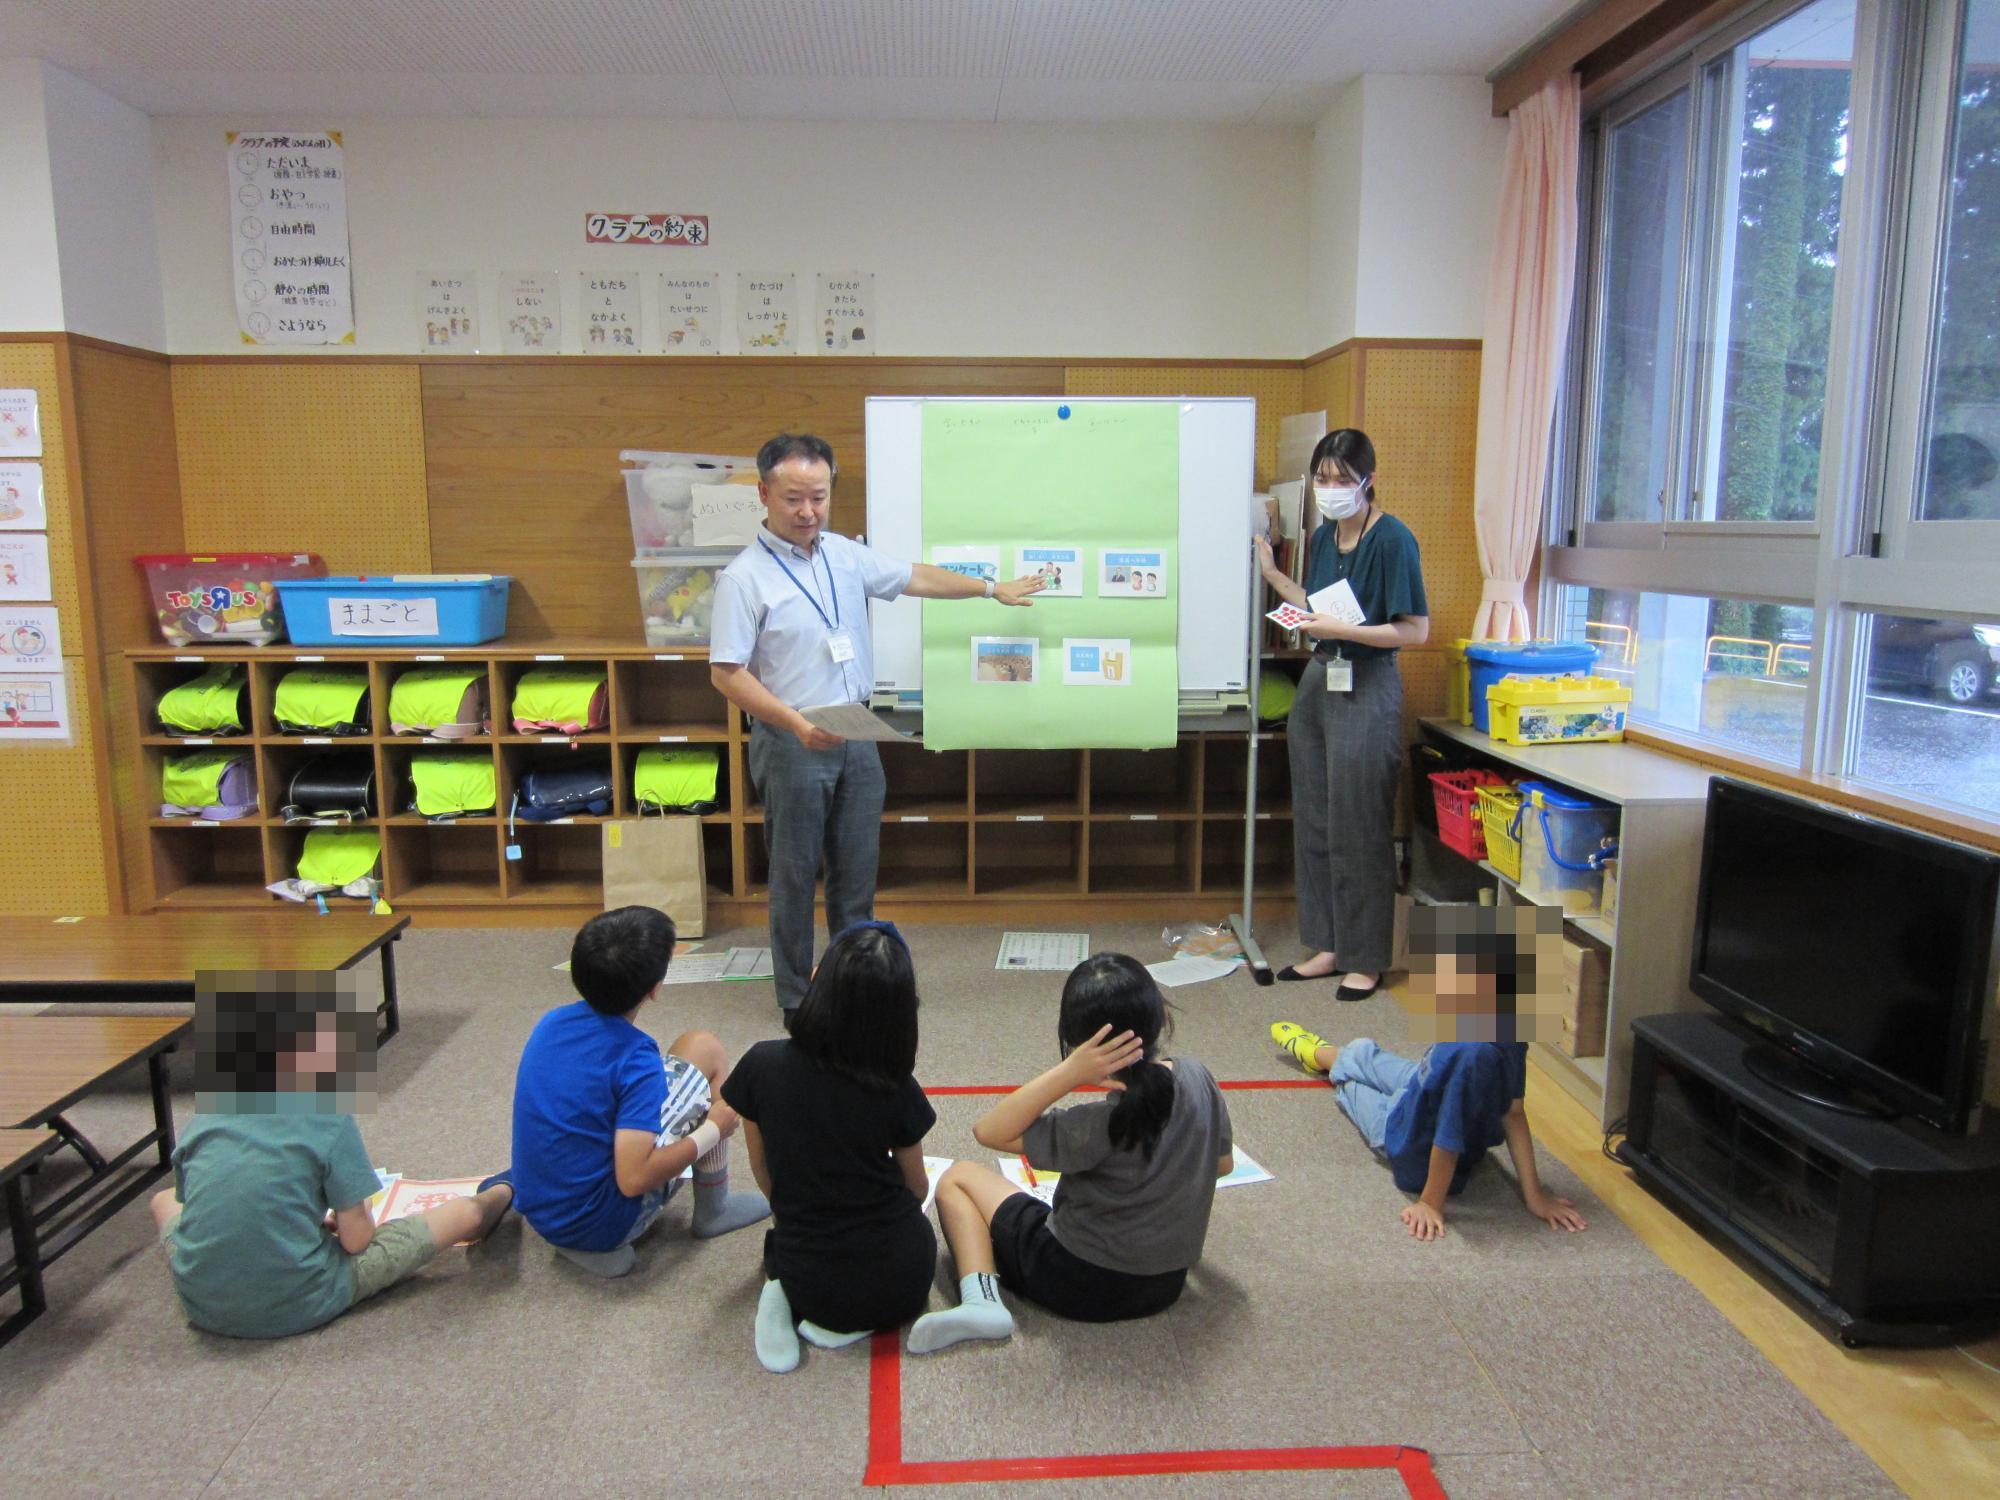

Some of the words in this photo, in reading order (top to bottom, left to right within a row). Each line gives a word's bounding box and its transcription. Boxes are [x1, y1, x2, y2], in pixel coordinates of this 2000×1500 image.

[266, 156, 311, 169] ただいま
[270, 187, 306, 200] おやつ
[271, 222, 316, 236] 自由時間
[591, 218, 703, 243] クラブの約束
[590, 280, 627, 290] ともだち
[667, 280, 710, 288] みんなのもの
[750, 282, 784, 291] かたづけ
[828, 281, 860, 290] むかえが
[685, 292, 692, 300] は
[834, 295, 857, 304] きたら
[516, 297, 542, 306] しない
[605, 297, 612, 306] と
[763, 297, 771, 305] は
[427, 306, 466, 315] げんきよく
[669, 305, 709, 313] たいせつに
[826, 308, 864, 317] すぐかえる
[591, 312, 626, 322] なかよく
[746, 312, 789, 320] しっかりと
[279, 319, 327, 332] さようなら
[343, 603, 420, 626] ままごと
